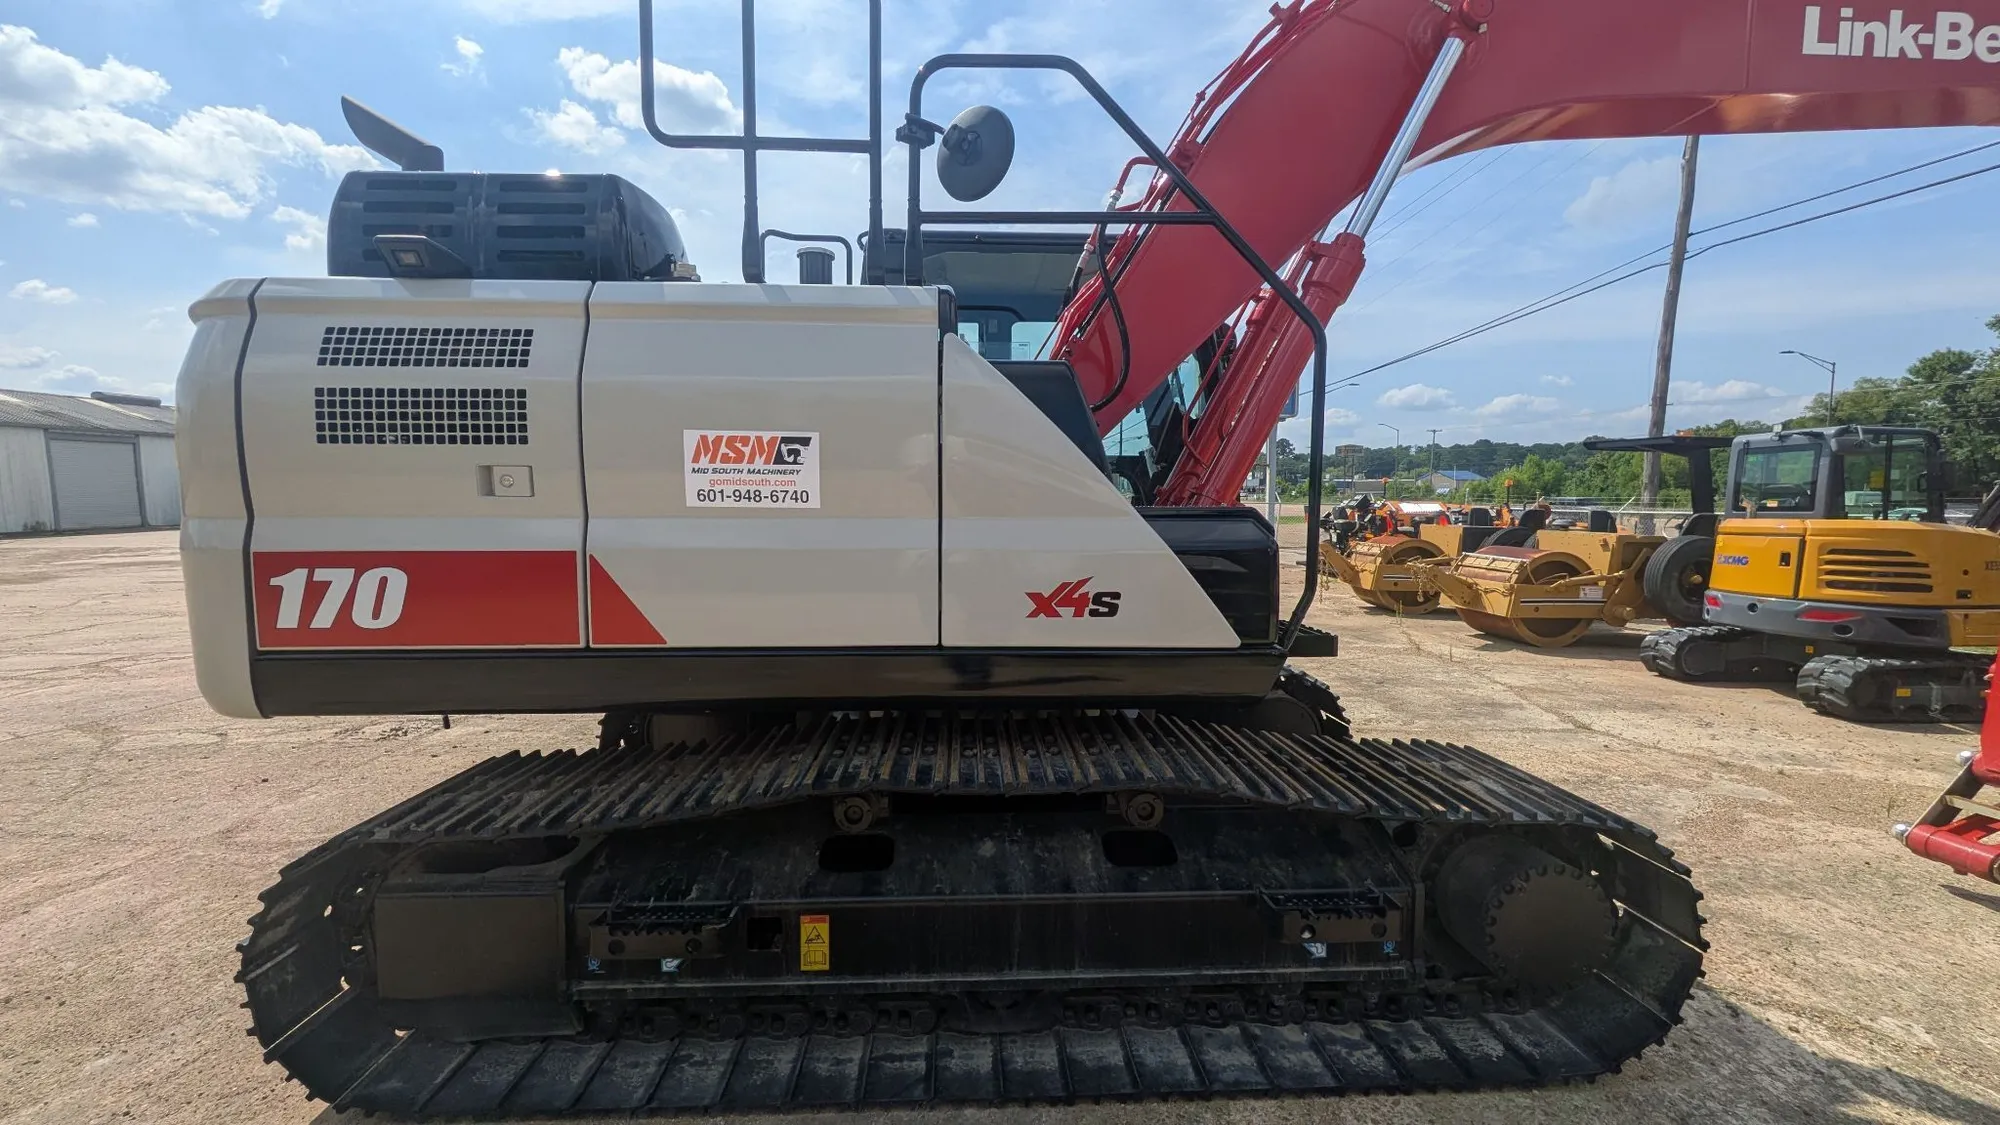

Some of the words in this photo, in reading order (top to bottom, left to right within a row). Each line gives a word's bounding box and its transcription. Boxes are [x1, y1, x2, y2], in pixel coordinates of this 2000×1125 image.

[691, 435, 779, 465] MSM
[691, 467, 709, 475] MID
[709, 478, 796, 487] gomidsouth.com
[697, 489, 809, 503] 601-948-6740
[269, 566, 408, 629] 170
